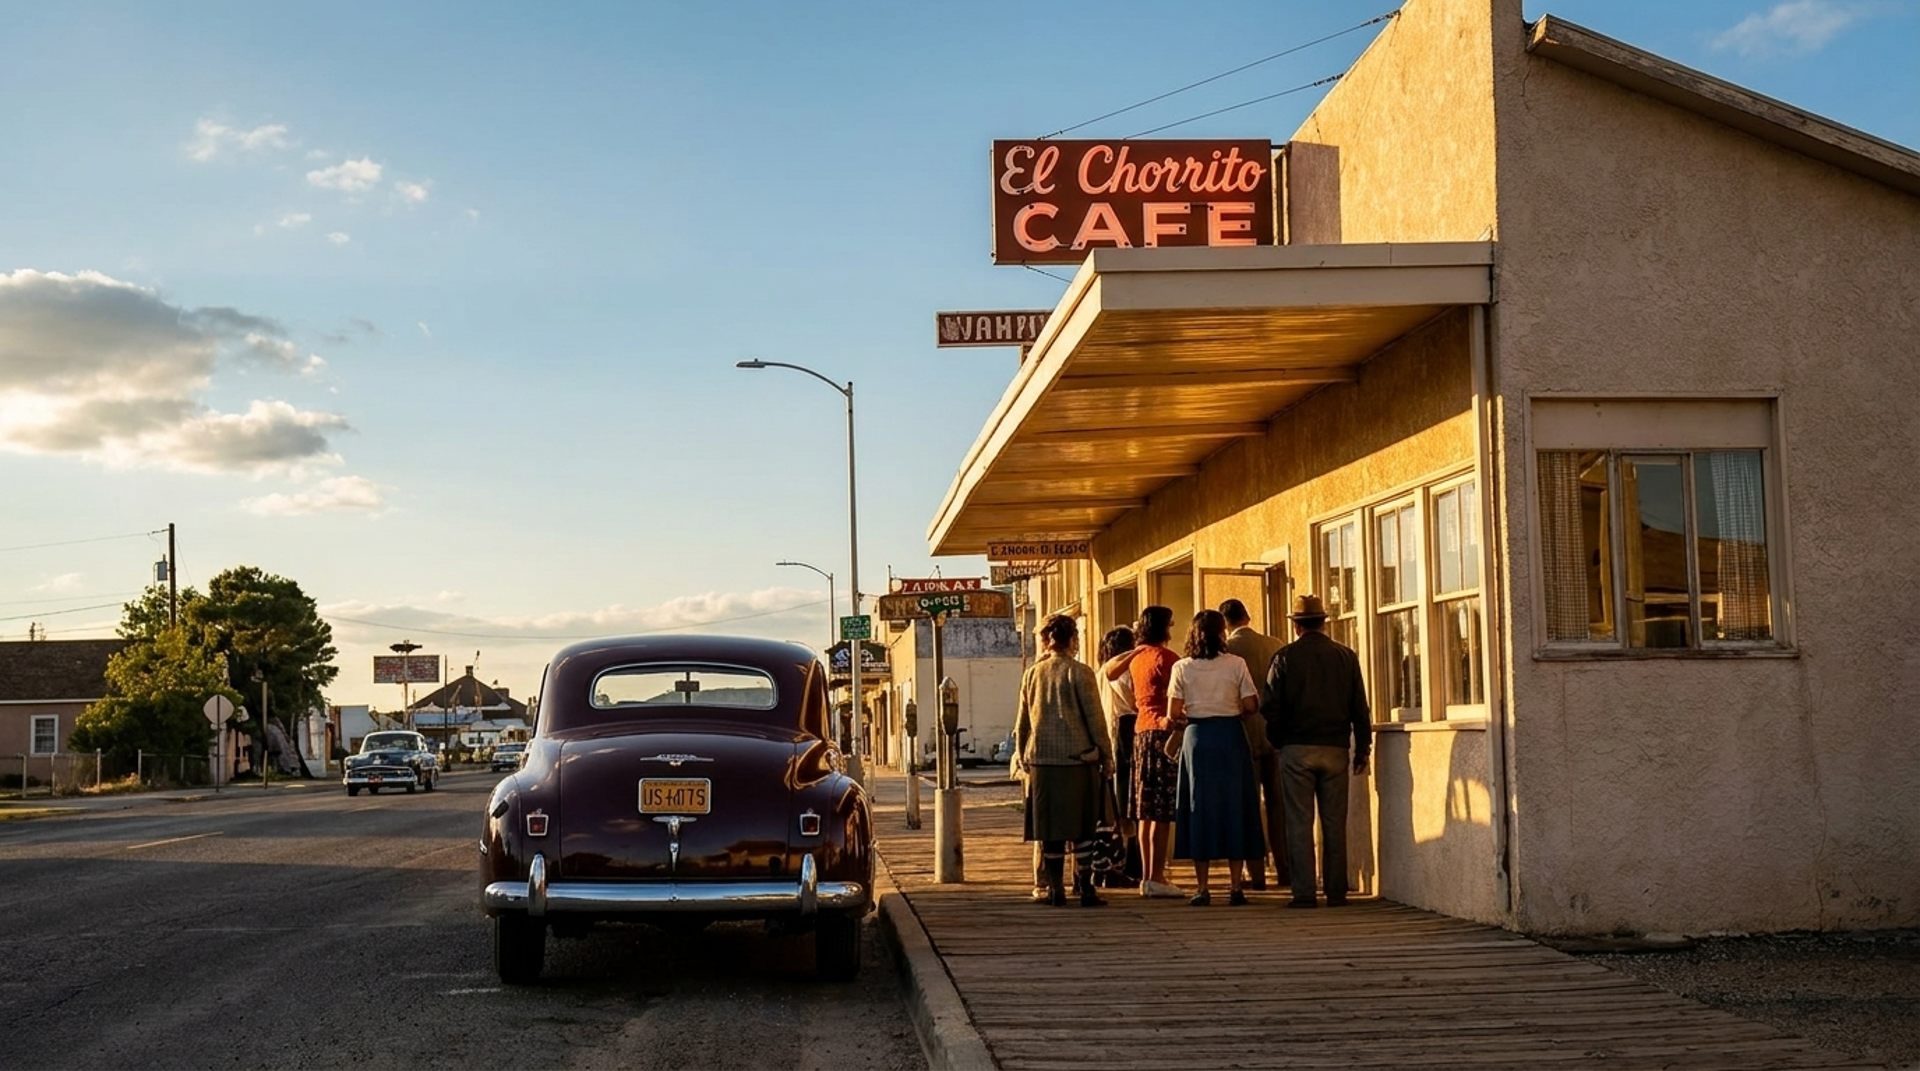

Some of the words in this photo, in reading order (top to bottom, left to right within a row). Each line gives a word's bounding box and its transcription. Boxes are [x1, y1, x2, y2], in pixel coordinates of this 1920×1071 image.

[1000, 145, 1060, 195] El
[1078, 145, 1267, 195] Chorrito
[1013, 202, 1257, 252] CAFE
